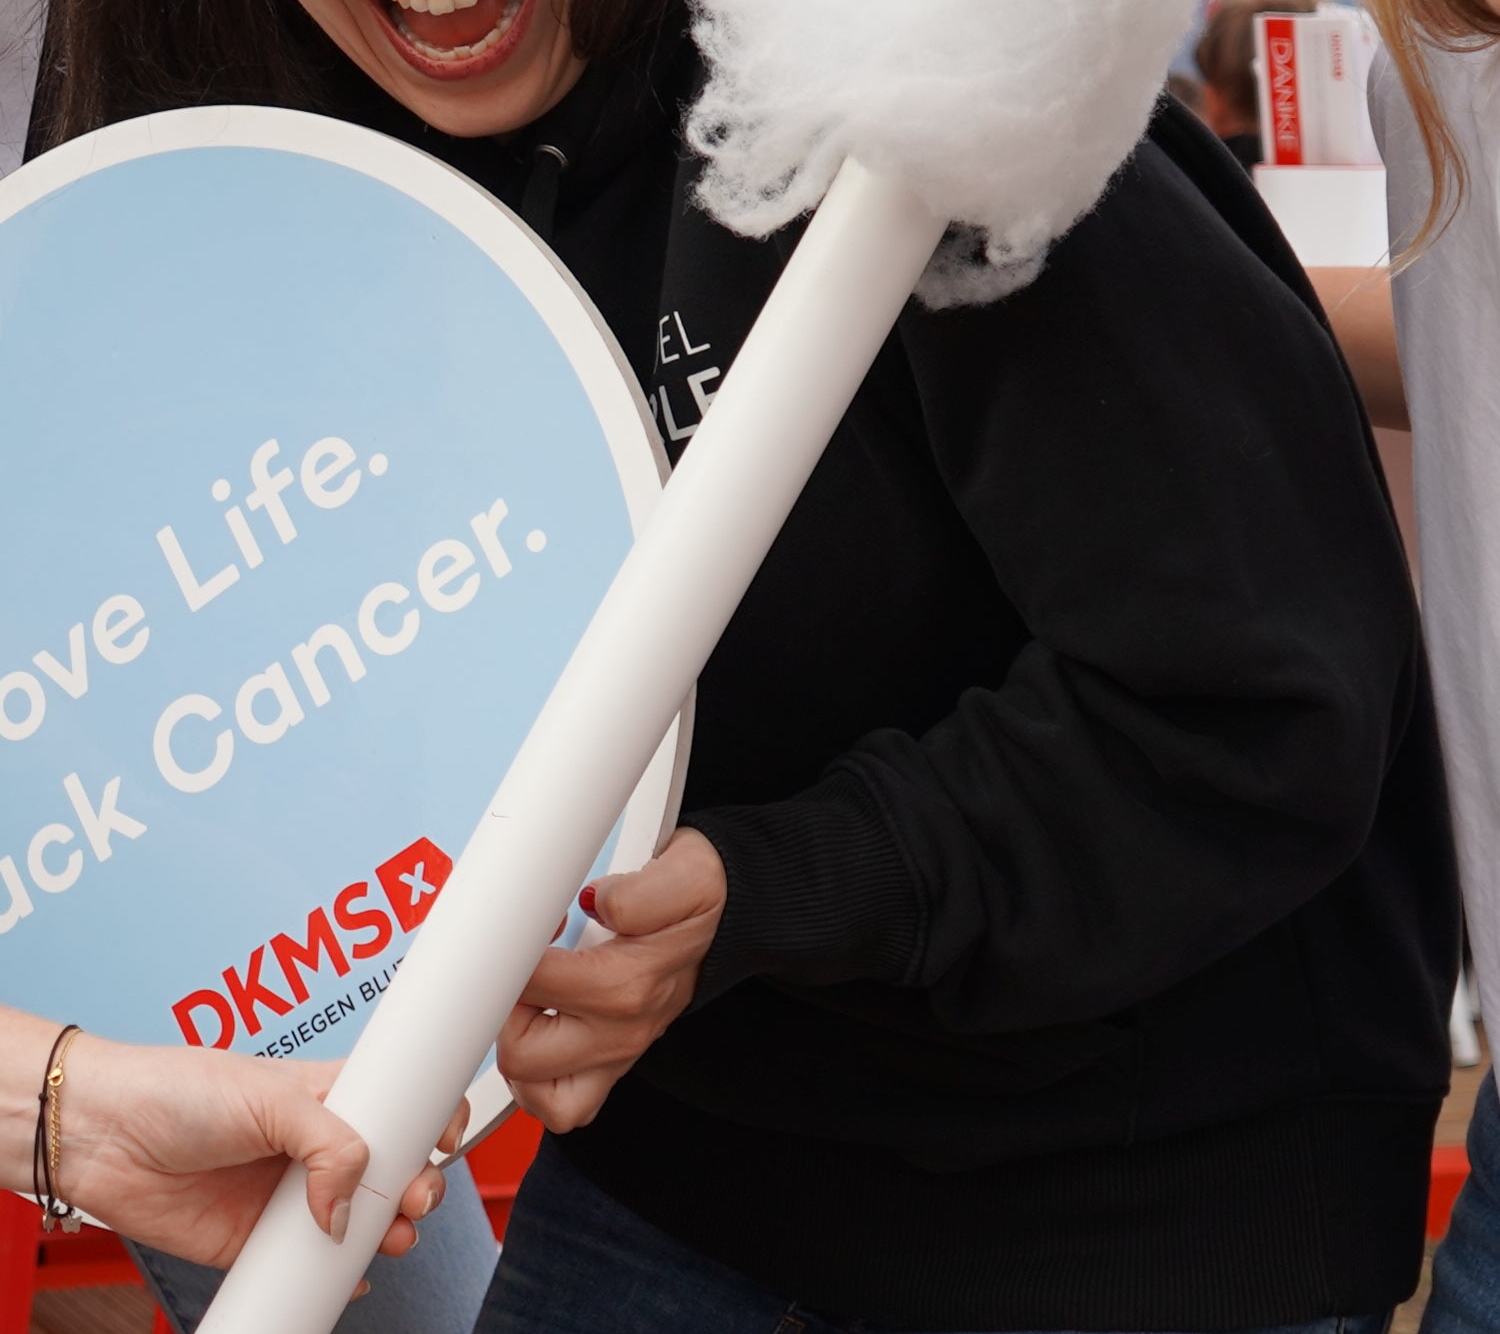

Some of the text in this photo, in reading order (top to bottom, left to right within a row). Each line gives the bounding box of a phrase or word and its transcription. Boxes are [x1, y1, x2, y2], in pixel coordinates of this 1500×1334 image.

[156, 436, 389, 612] Life.
[153, 498, 548, 793] Cancer.
[171, 881, 393, 1051] DKMS
